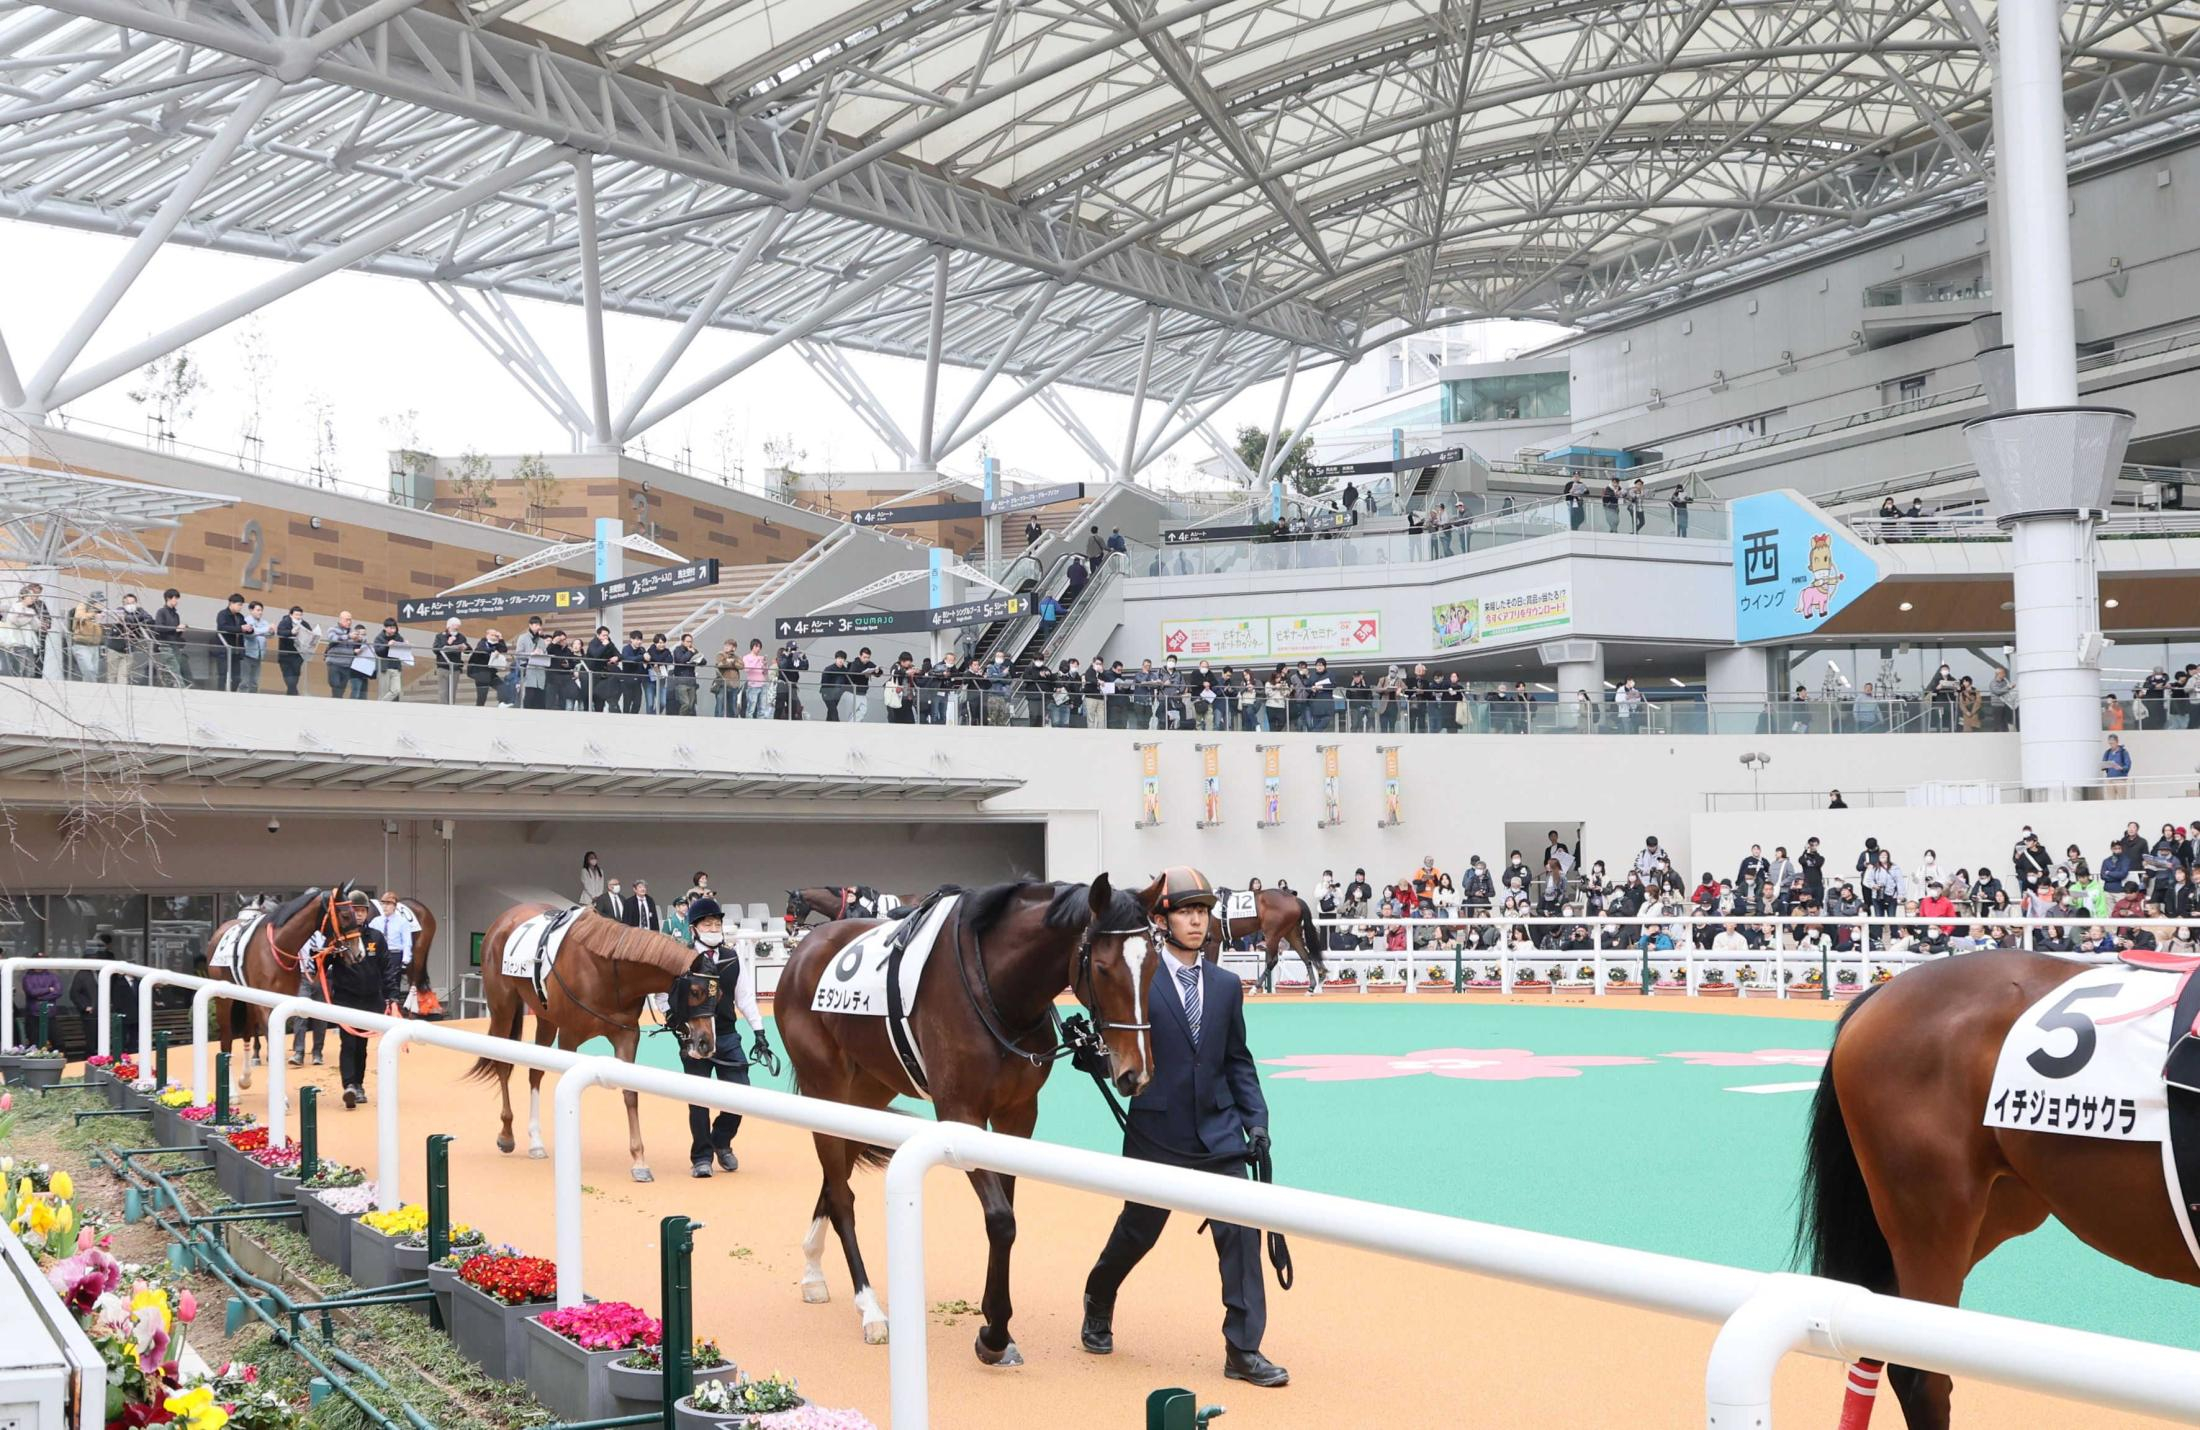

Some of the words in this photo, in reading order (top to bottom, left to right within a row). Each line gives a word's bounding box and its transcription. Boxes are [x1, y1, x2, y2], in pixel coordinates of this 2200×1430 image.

[864, 512, 876, 522] 4F
[1178, 531, 1189, 542] 4F
[240, 519, 280, 592] 2F
[1742, 528, 1779, 585] 西
[600, 587, 608, 602] 1F
[632, 580, 641, 595] 2F
[1740, 589, 1785, 611] ウイング
[416, 603, 430, 617] 4F
[431, 601, 454, 610] Aシート
[456, 595, 550, 609] グループテーブル・グループソファ
[932, 612, 942, 625] 4F
[983, 604, 993, 617] 5F
[794, 621, 809, 634] 4F
[811, 620, 834, 628] Aシート
[838, 618, 853, 632] 3F
[1223, 630, 1250, 640] ビギナーズ
[1276, 629, 1337, 640] ビギナーズセミナー
[1235, 895, 1252, 910] 12
[510, 923, 536, 956] 7
[835, 929, 880, 982] 6
[818, 988, 870, 1011] モダンレディ
[2026, 983, 2124, 1079] 5
[1994, 1088, 2136, 1134] イチジョウサクラ
